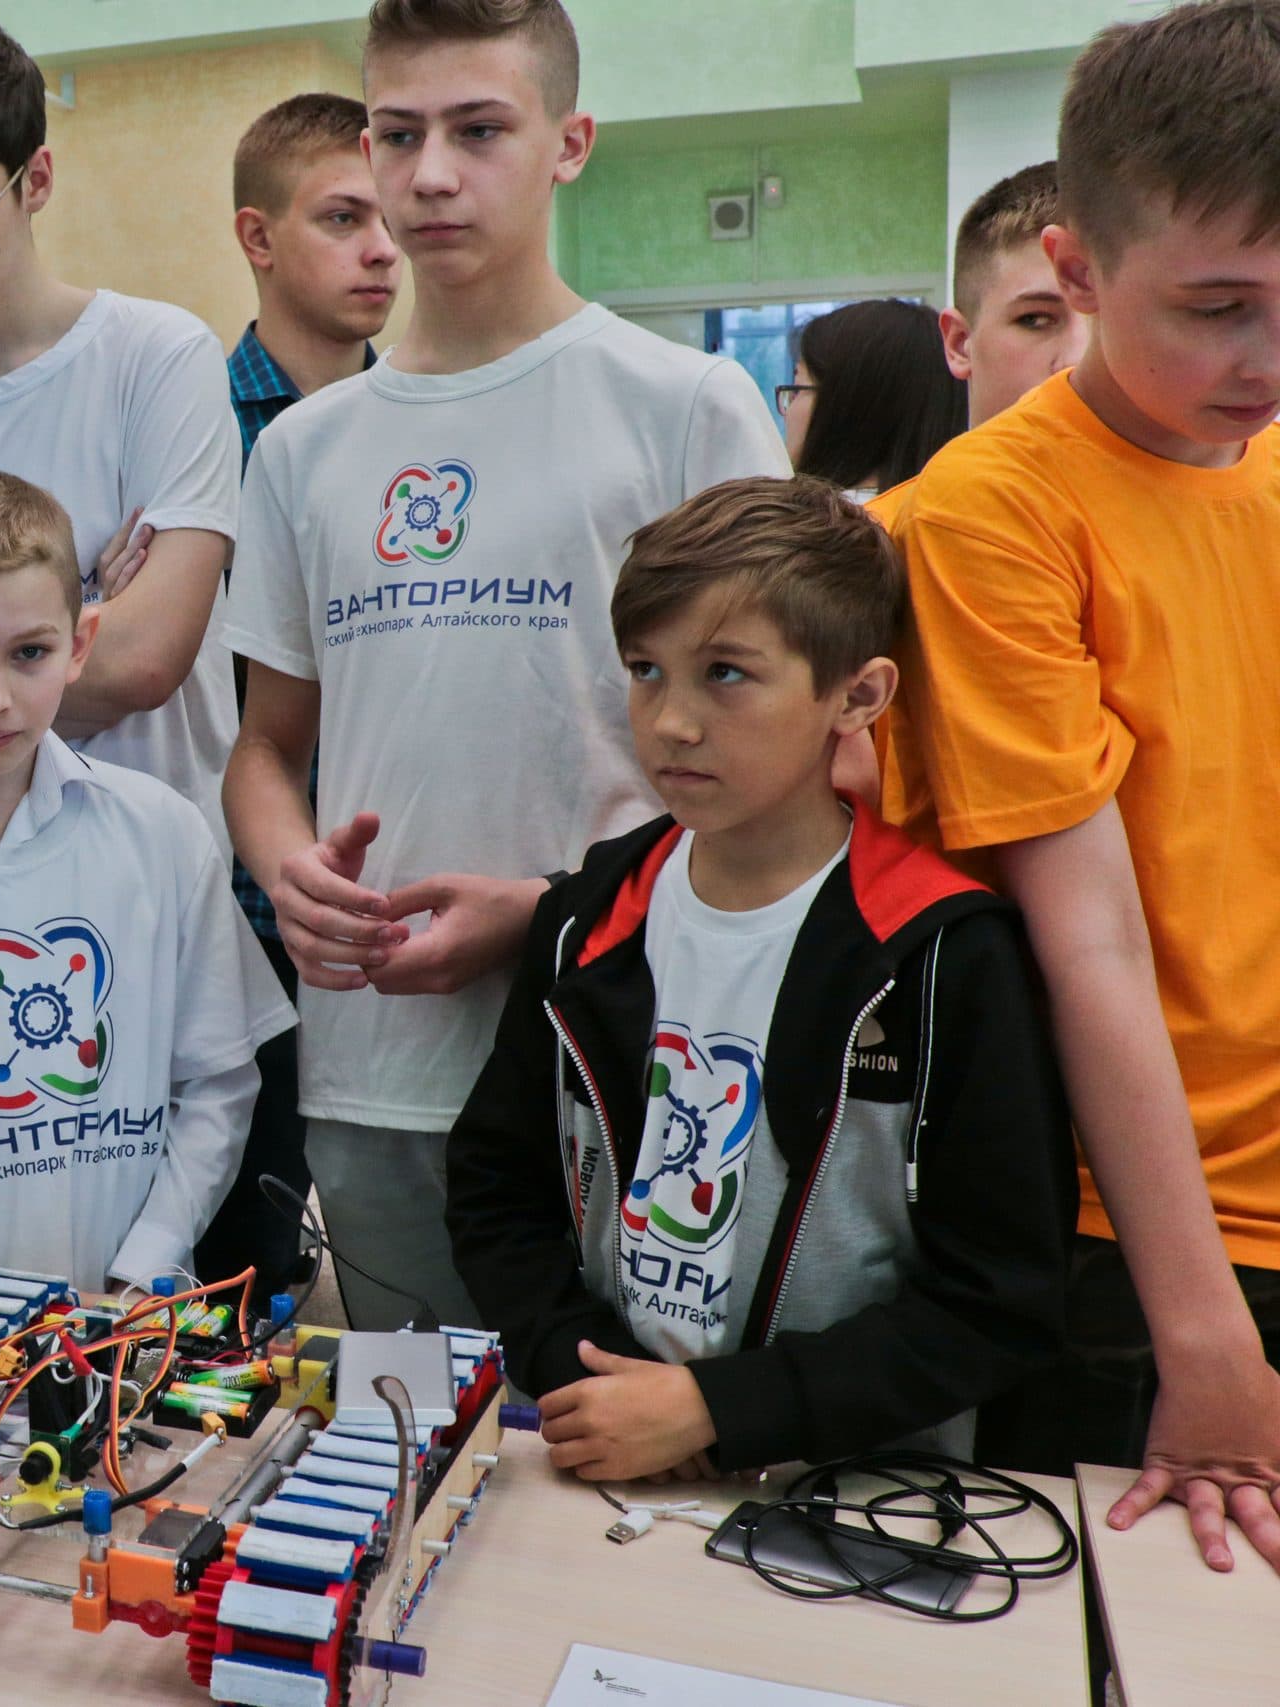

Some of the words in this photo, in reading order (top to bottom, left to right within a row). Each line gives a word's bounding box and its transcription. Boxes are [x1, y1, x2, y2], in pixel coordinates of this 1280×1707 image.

[420, 610, 521, 628] Алтайского
[528, 614, 568, 631] края
[848, 1052, 899, 1072] SHION
